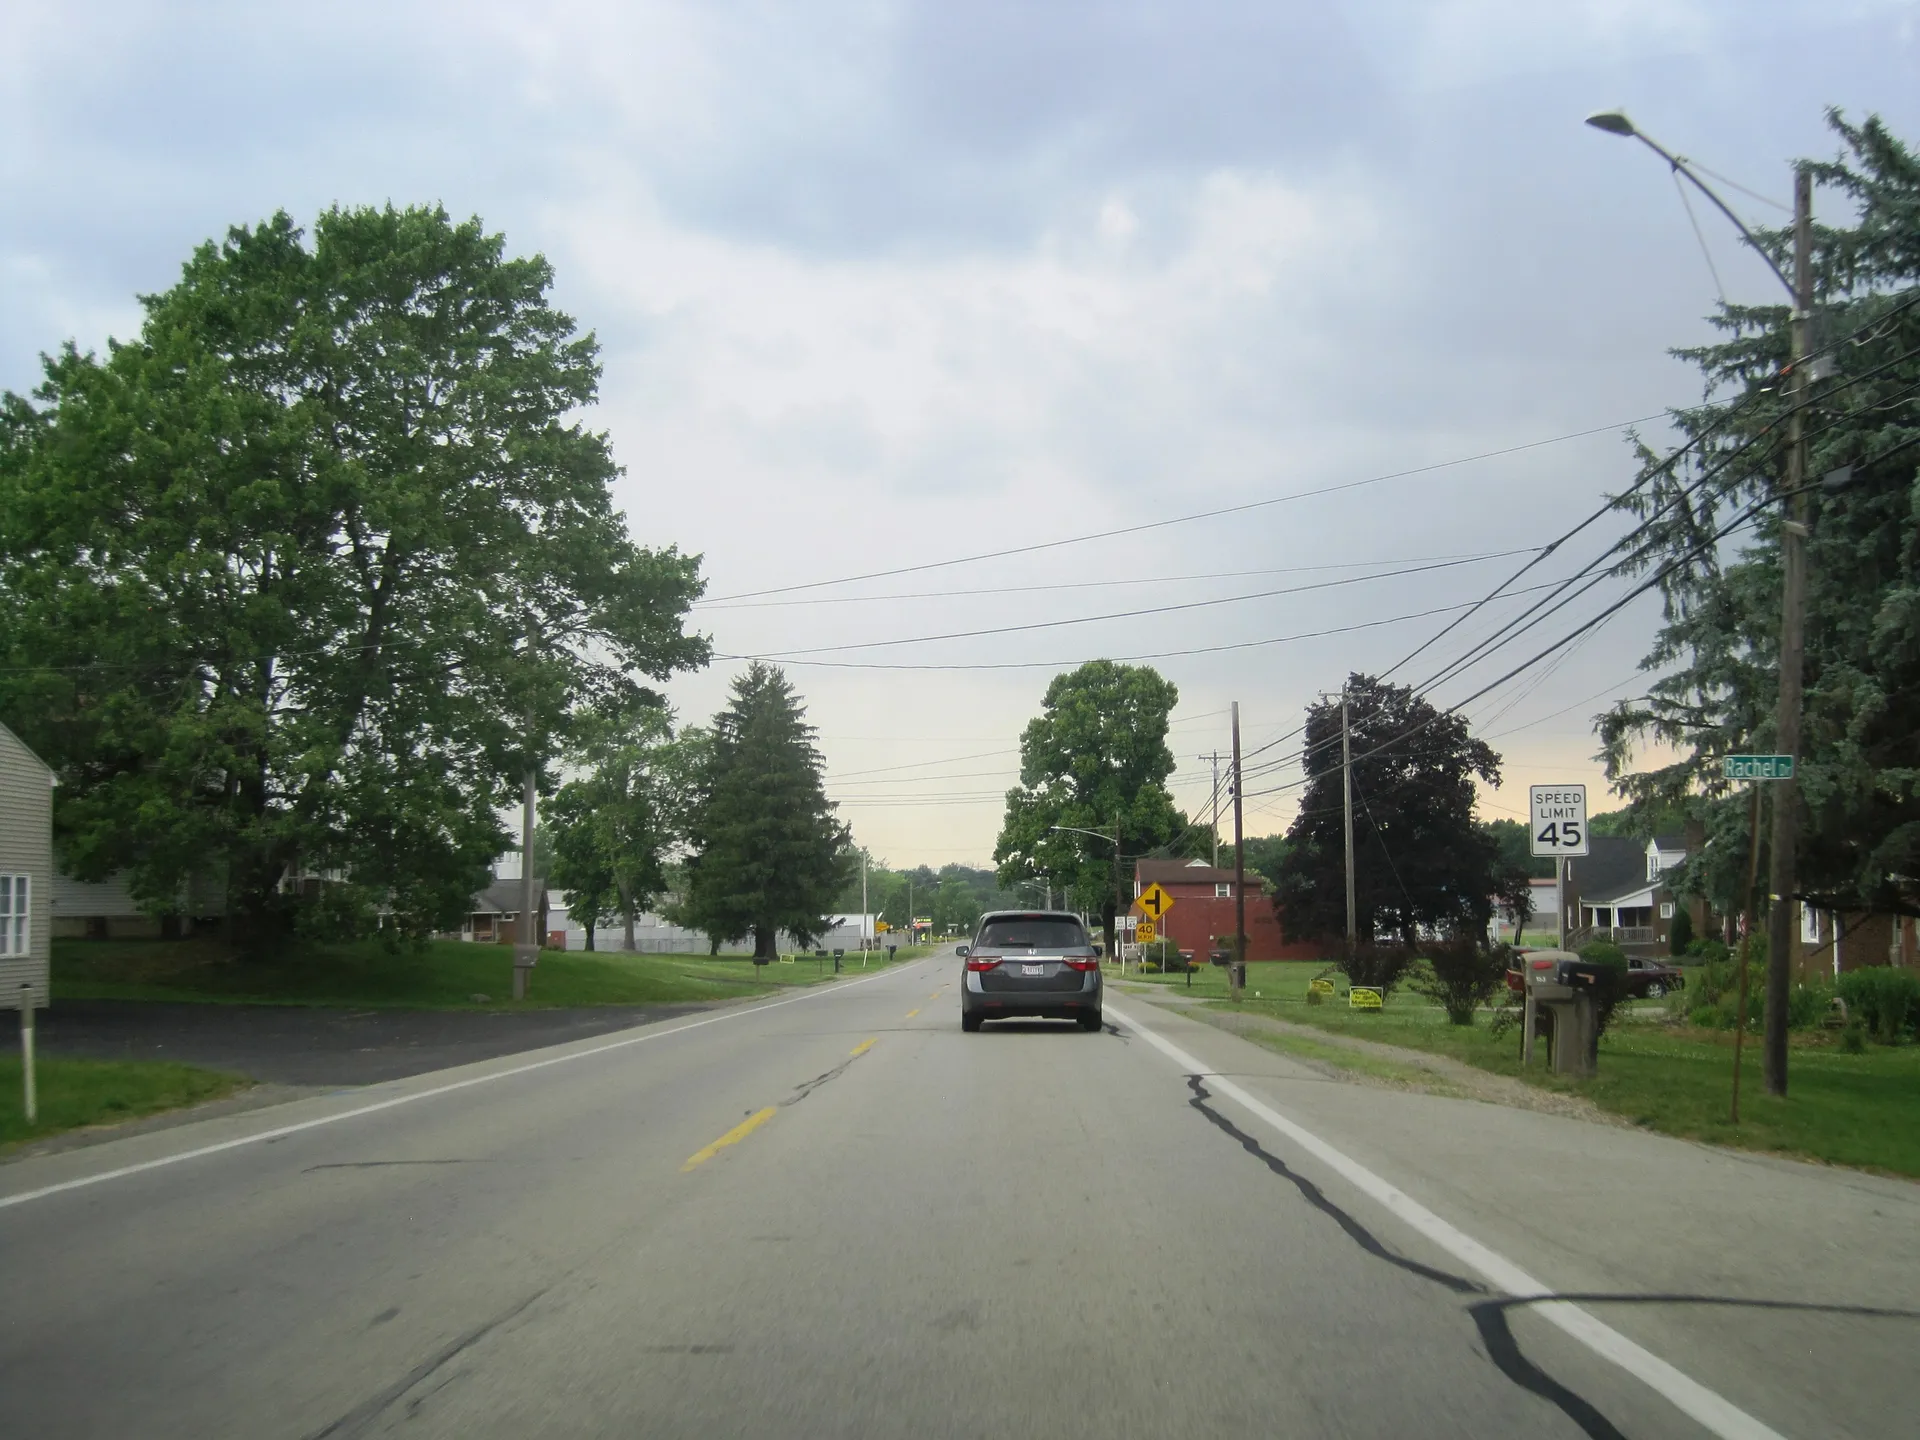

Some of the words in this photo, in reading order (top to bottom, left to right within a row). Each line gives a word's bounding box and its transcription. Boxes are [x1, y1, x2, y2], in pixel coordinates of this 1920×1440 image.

[1725, 758, 1776, 776] Rachel
[1535, 793, 1582, 804] SPEED
[1540, 807, 1576, 818] LIMIT
[1537, 822, 1581, 847] 45
[1138, 925, 1153, 934] 40
